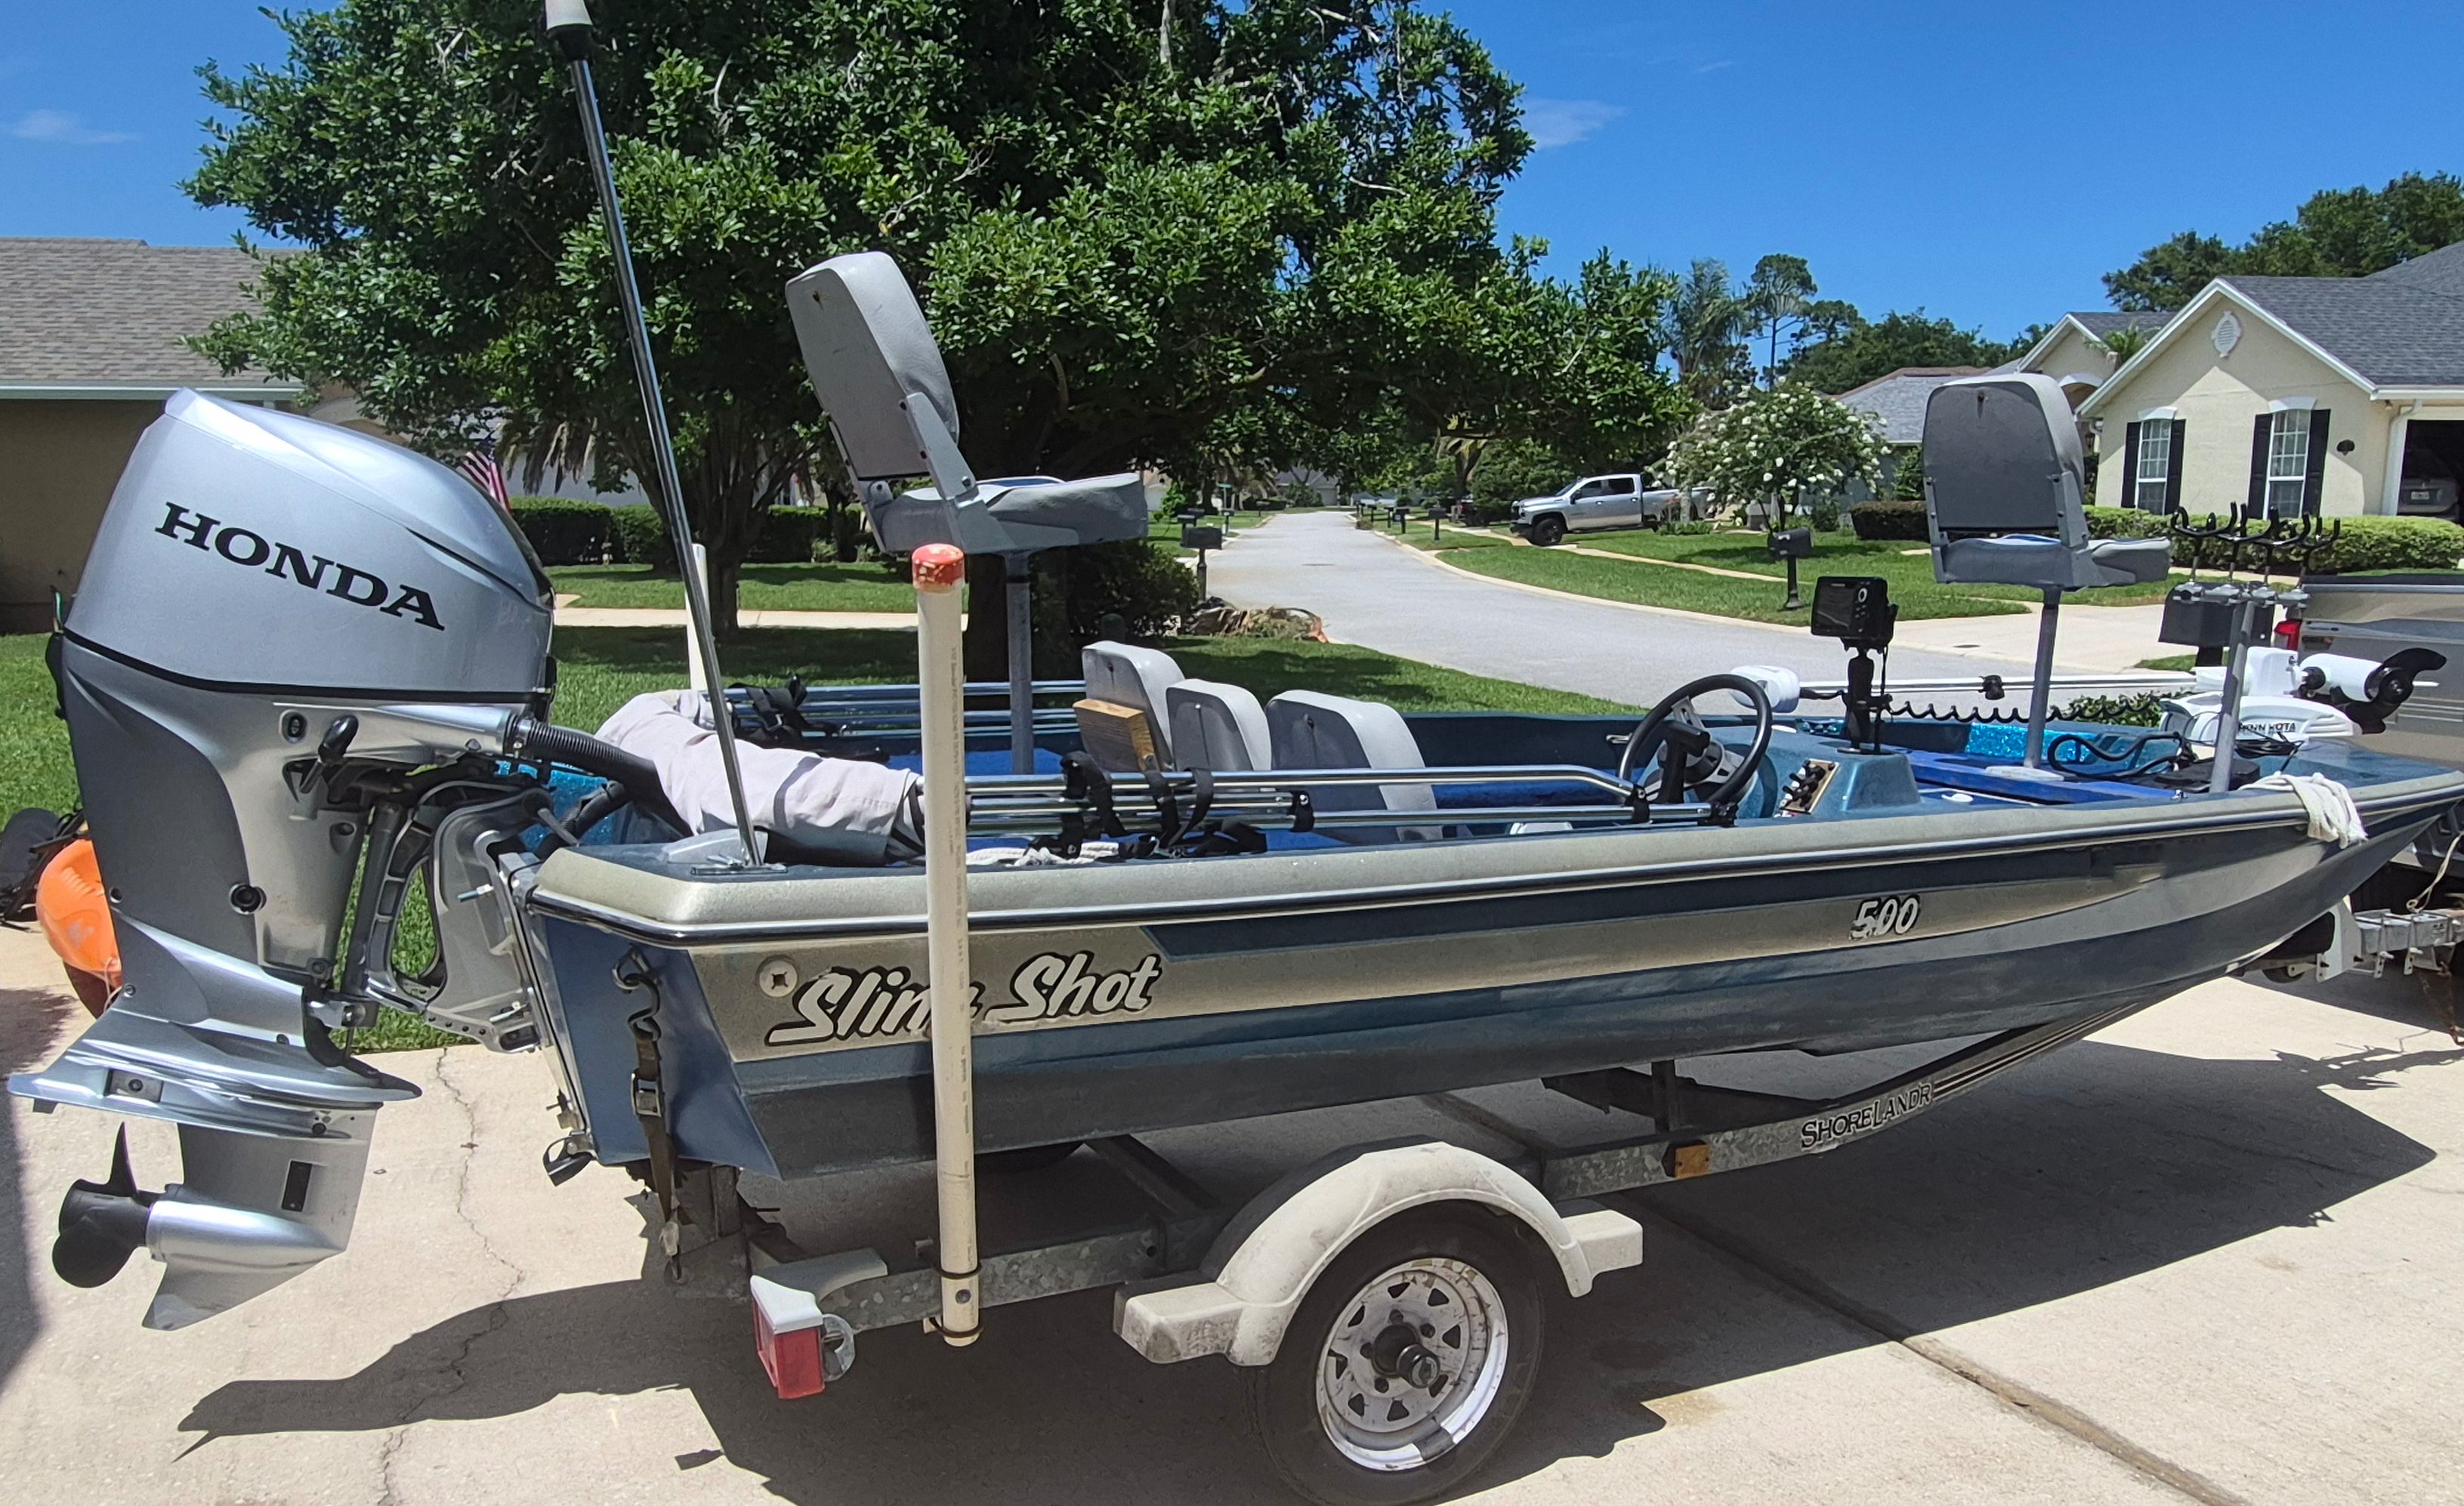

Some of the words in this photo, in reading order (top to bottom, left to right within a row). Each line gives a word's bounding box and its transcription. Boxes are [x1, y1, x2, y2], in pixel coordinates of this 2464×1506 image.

[155, 502, 445, 631] HONDA
[1849, 893, 1921, 940] 500
[983, 950, 1162, 1023] Shot
